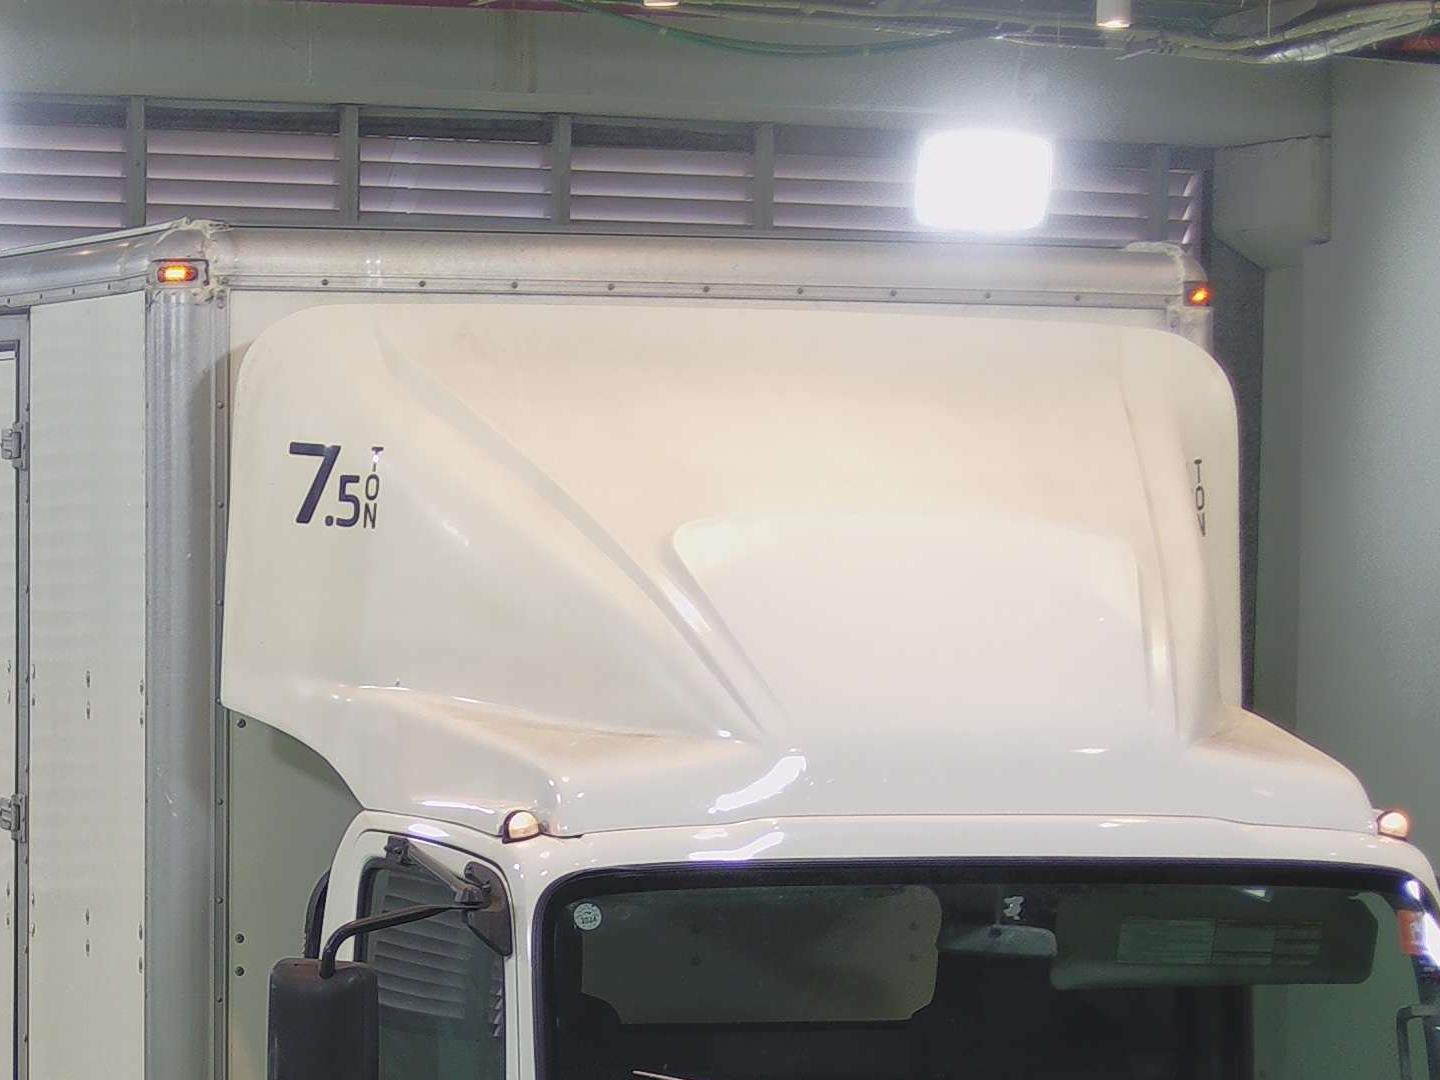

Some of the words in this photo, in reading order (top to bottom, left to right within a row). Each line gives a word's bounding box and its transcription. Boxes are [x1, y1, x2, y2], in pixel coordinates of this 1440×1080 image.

[289, 441, 360, 527] 7.5
[363, 446, 385, 529] TON
[1193, 458, 1206, 537] TON
